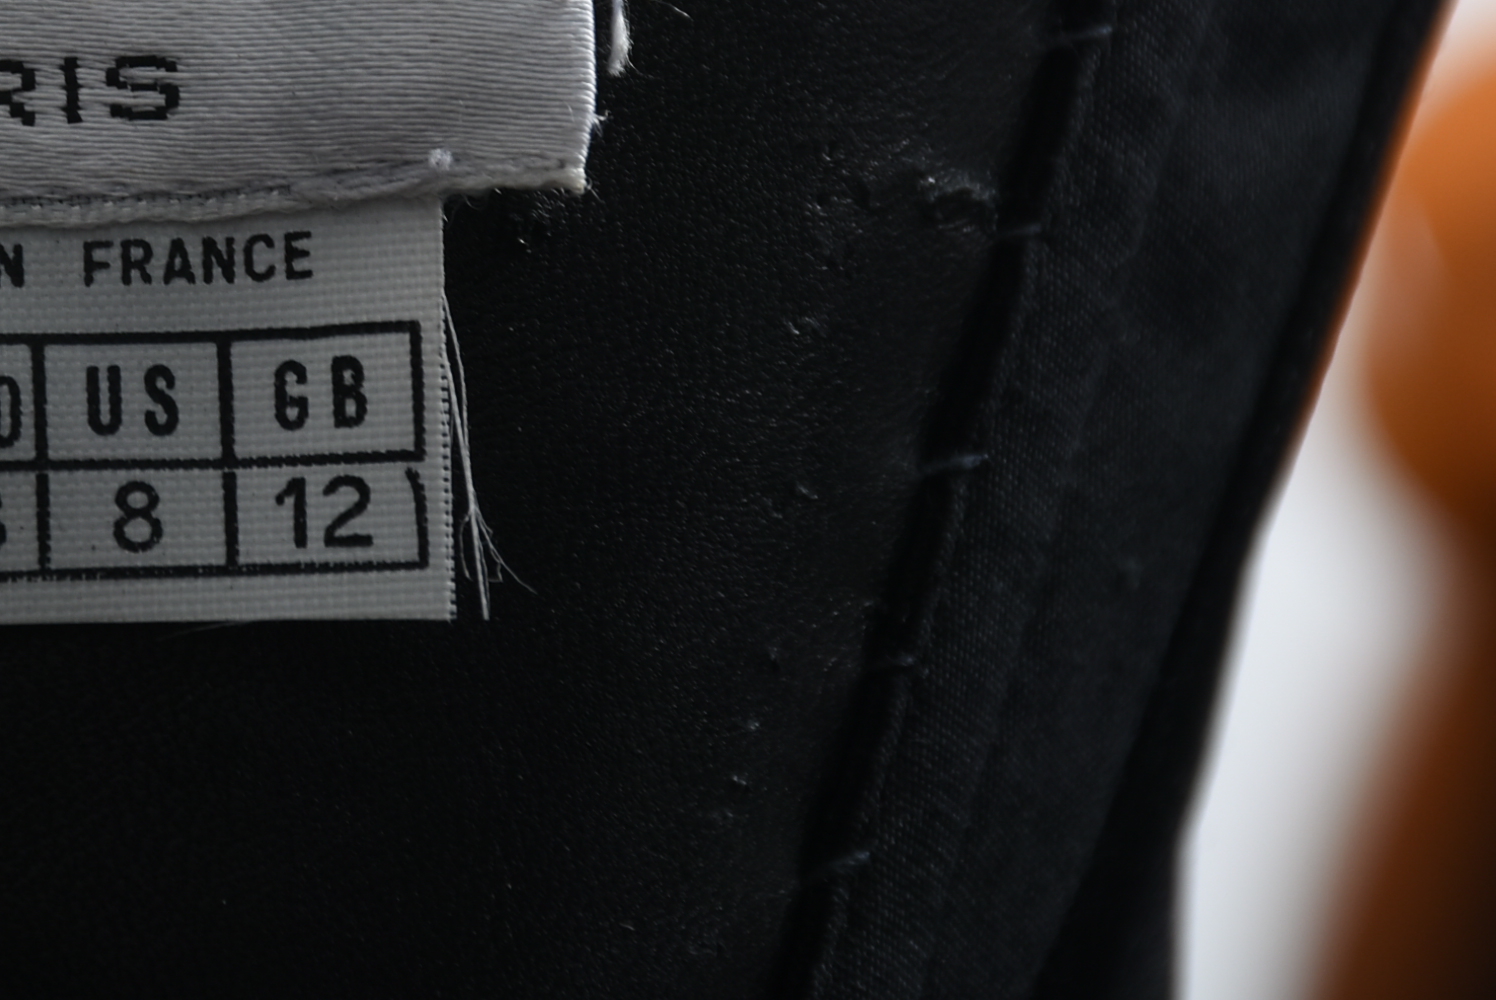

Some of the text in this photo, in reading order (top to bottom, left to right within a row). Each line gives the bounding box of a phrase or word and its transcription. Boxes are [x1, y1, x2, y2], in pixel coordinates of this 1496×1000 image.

[82, 230, 315, 287] FRANCE
[85, 364, 181, 438] US
[273, 354, 370, 432] GB
[112, 480, 164, 554] 8
[273, 473, 374, 551] 12
